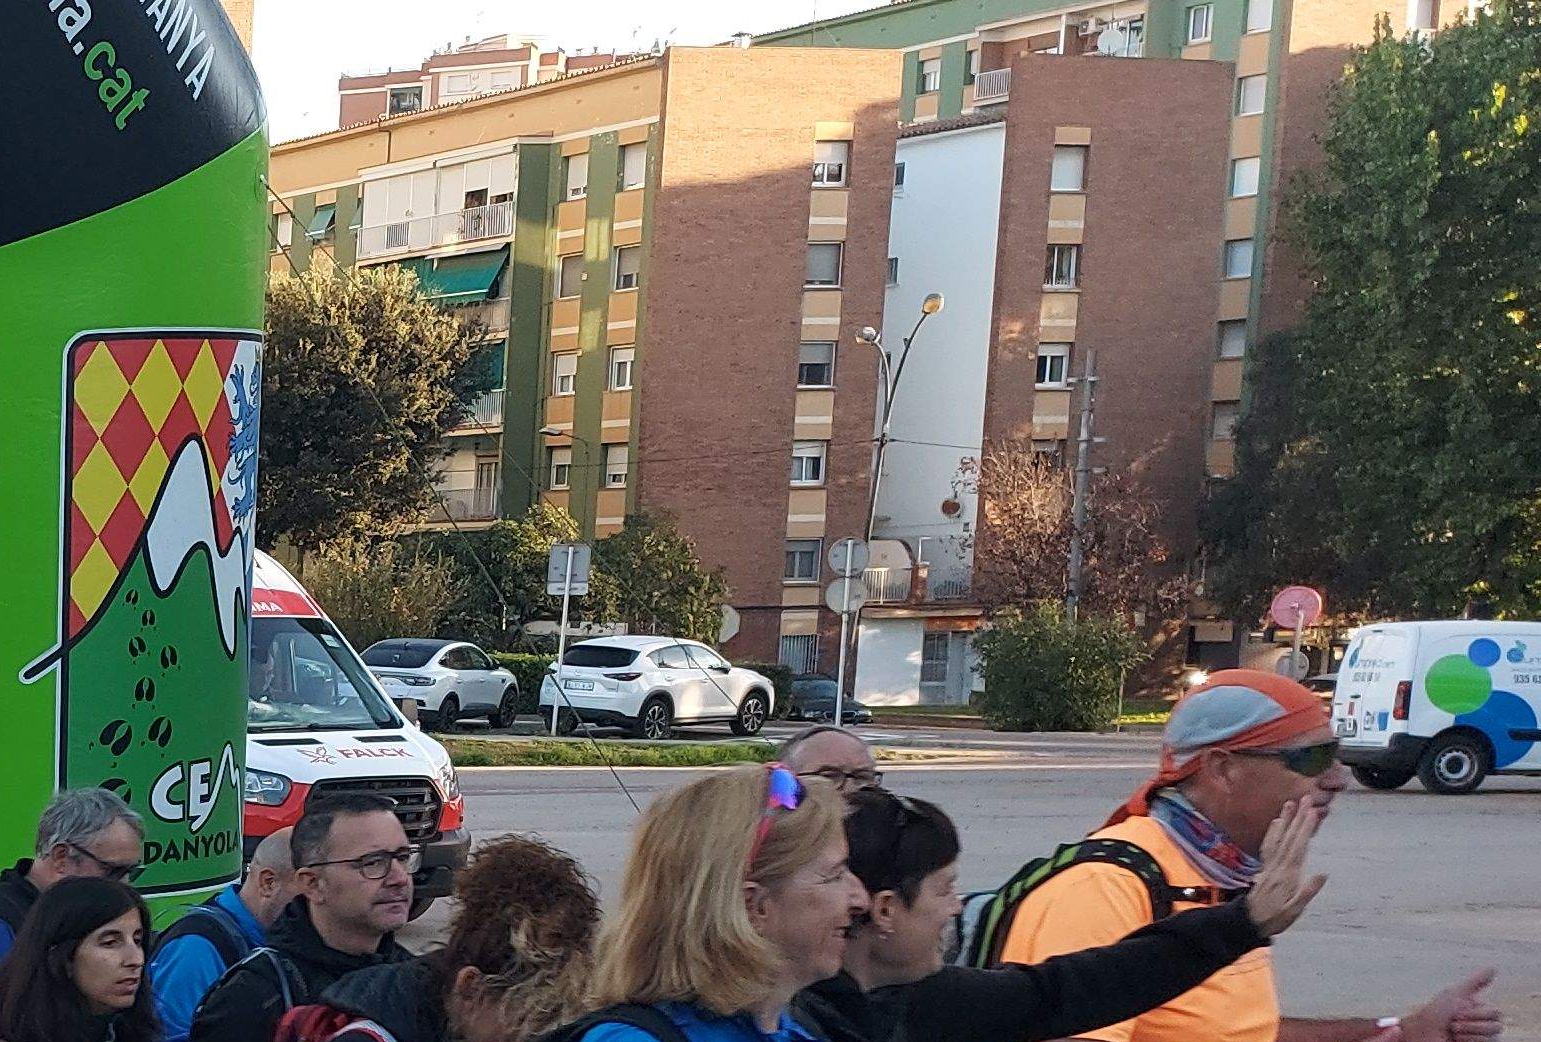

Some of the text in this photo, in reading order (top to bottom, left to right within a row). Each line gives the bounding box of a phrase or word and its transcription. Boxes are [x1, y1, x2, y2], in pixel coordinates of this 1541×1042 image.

[48, 0, 150, 130] a.cat
[139, 0, 215, 101] ANYA
[337, 748, 414, 759] FALCK
